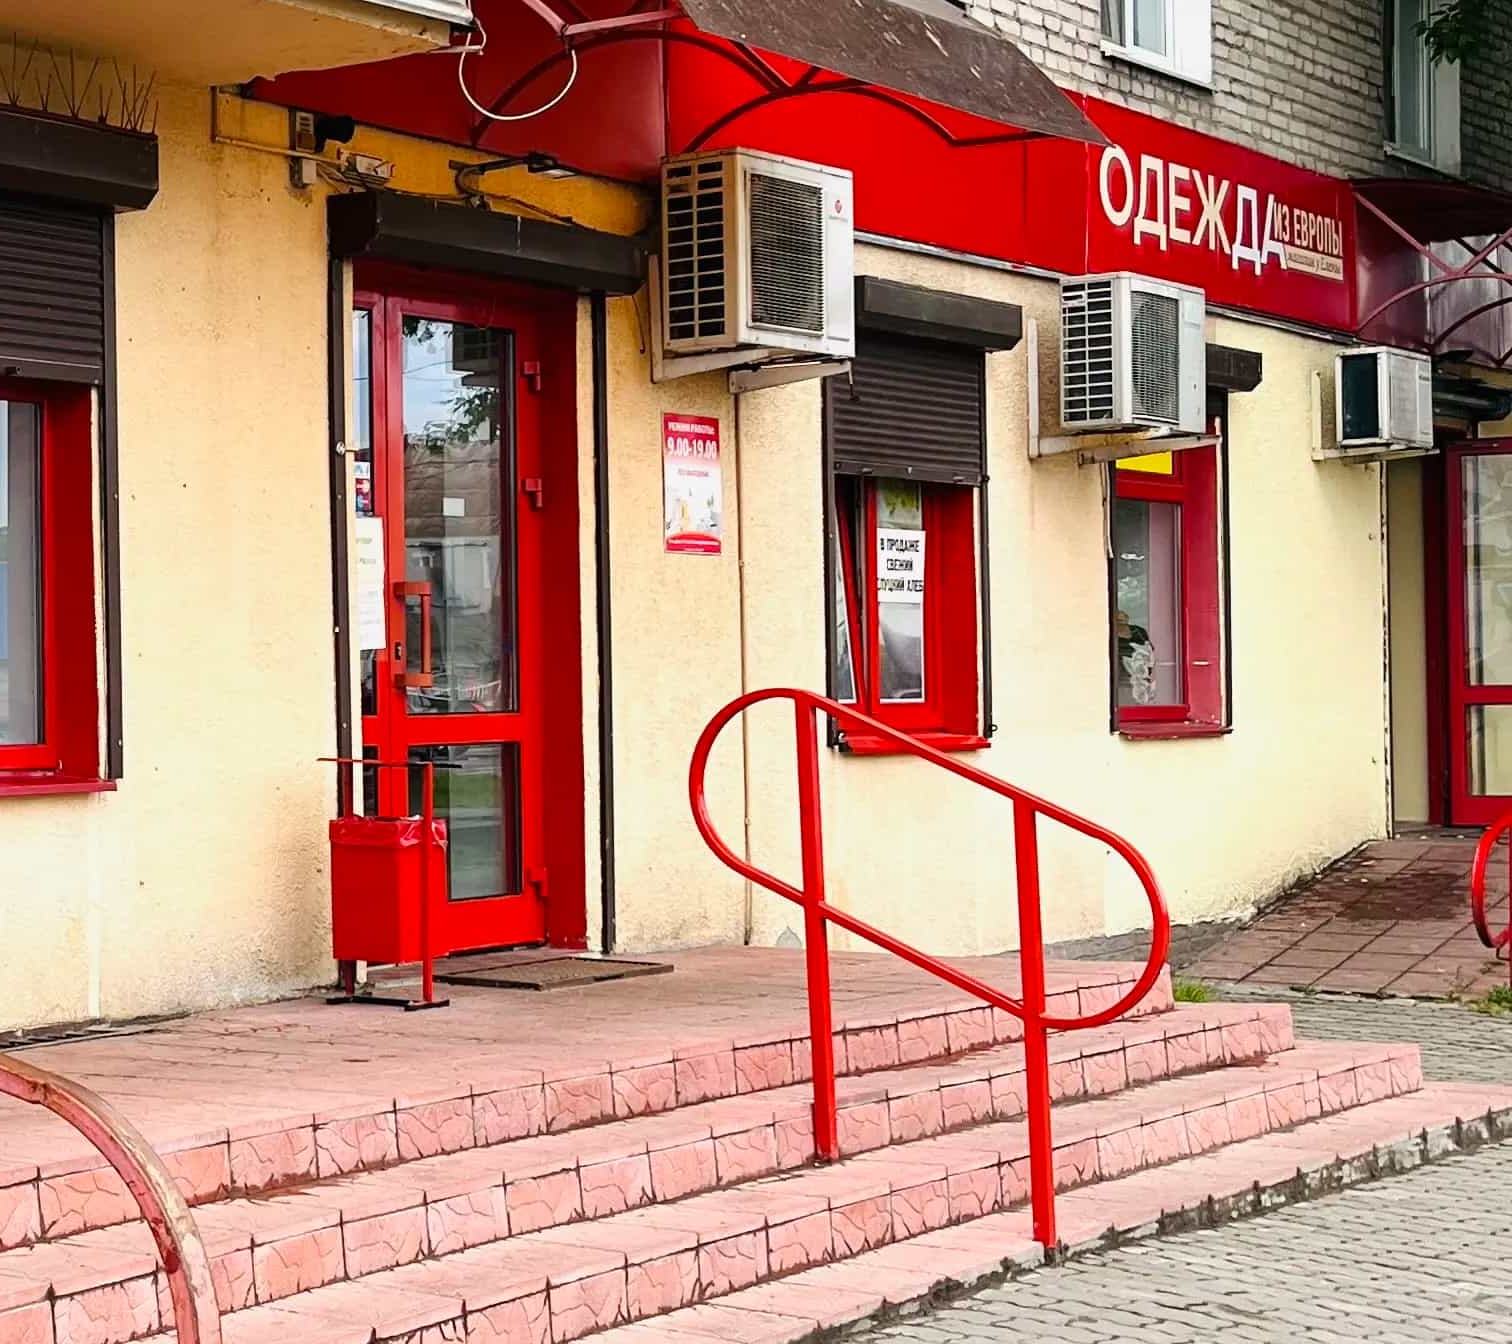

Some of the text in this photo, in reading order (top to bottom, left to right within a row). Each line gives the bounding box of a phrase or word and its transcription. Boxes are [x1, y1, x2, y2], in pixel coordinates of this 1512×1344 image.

[1099, 144, 1288, 276] ОДЕЖДА
[1274, 201, 1344, 258] ИЗ ЕВРОПЫ
